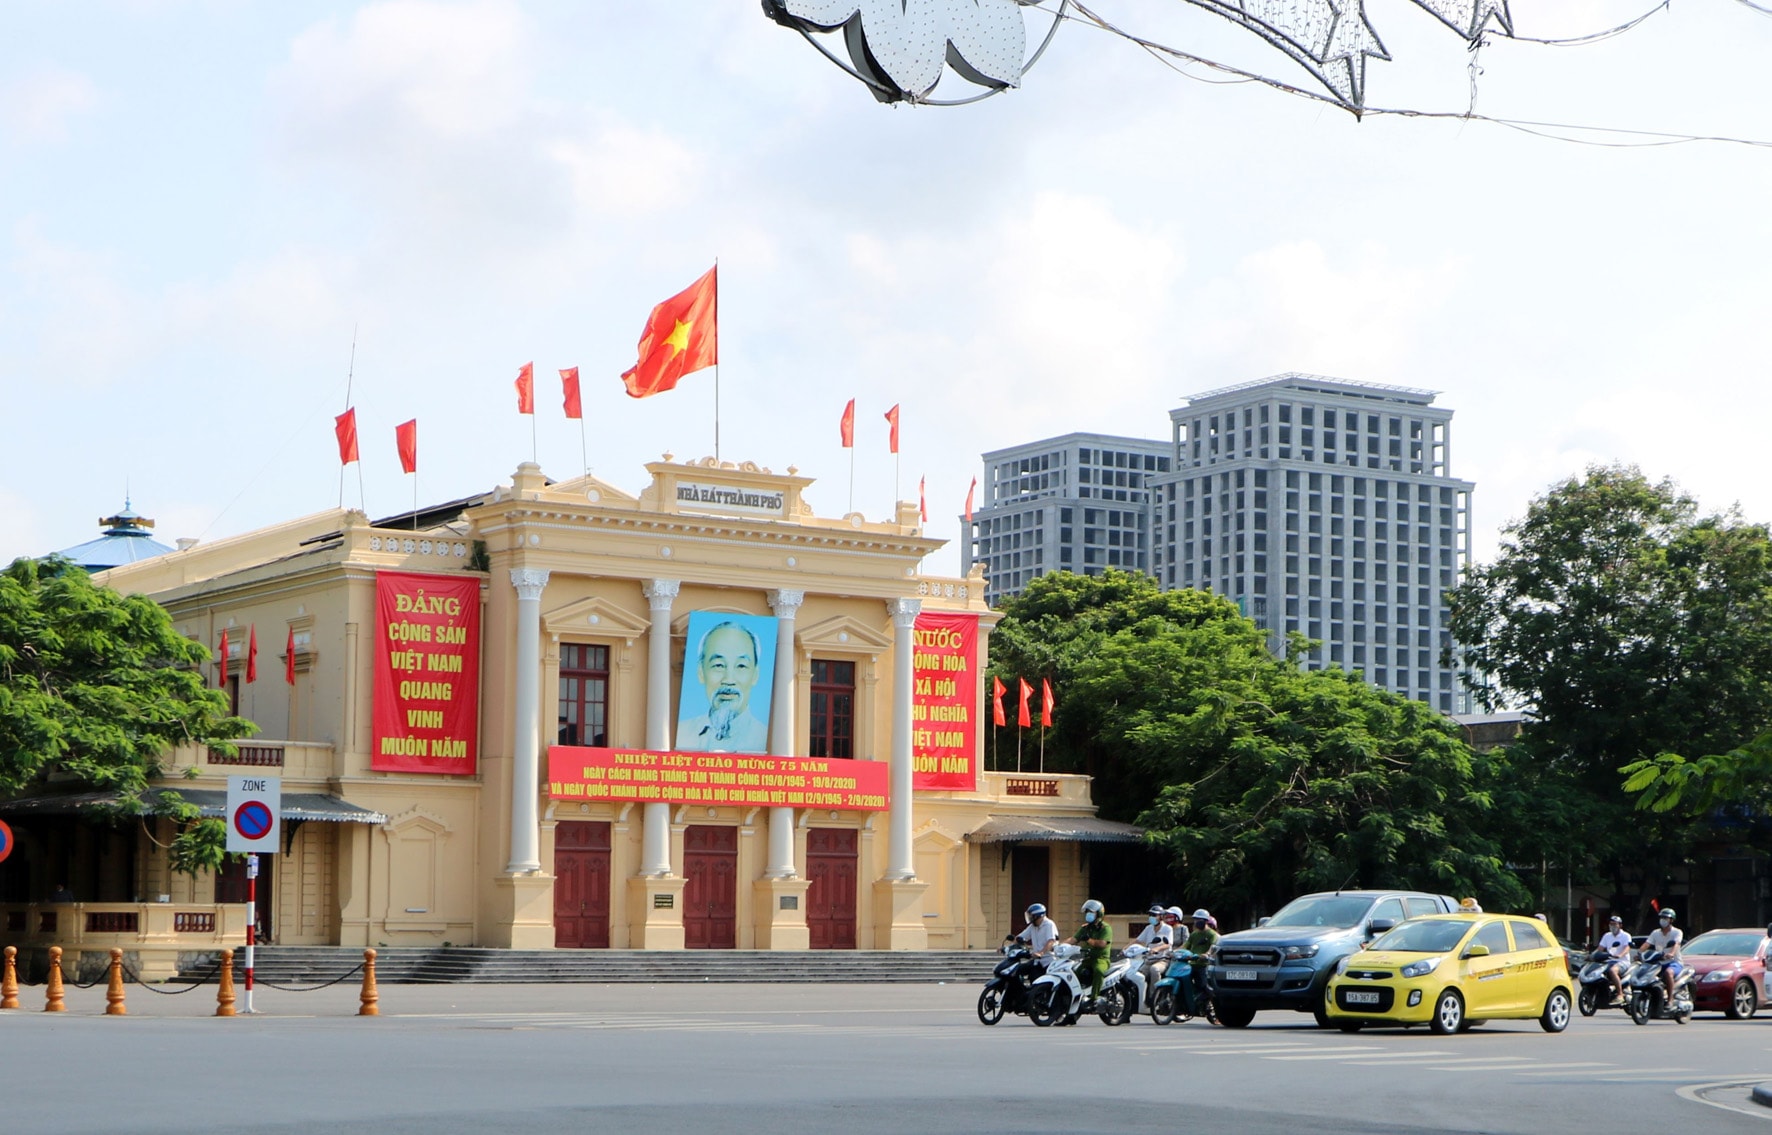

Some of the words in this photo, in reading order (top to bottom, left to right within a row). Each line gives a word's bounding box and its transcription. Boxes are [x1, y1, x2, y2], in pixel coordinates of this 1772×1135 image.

[677, 485, 699, 501] NHÀ
[701, 487, 722, 503] HÁT
[723, 489, 760, 507] THÀNH
[760, 493, 784, 509] PHỐ
[396, 588, 461, 616] ĐẢNG
[389, 619, 431, 645] CỘNG
[436, 619, 466, 644] SẢN
[913, 627, 963, 649] NƯỚC
[391, 649, 424, 674] VIỆT
[428, 653, 462, 673] NAM
[913, 653, 939, 674] ỘNG
[943, 654, 967, 672] HÒA
[400, 680, 452, 700] QUANG
[916, 677, 932, 696] XÃ
[935, 680, 956, 699] HỘI
[407, 709, 443, 728] VINH
[912, 698, 926, 721] HỦ
[930, 704, 968, 722] NGHĨA
[381, 735, 427, 757] MUÔN
[431, 736, 467, 758] NĂM
[912, 728, 932, 750] IỆT
[935, 731, 964, 748] NAM
[615, 753, 658, 766] NHIỆT
[662, 755, 693, 767] LIỆT
[697, 757, 733, 768] CHÀO
[737, 758, 775, 770] MỪNG
[780, 761, 797, 771] 75
[801, 761, 829, 773] NĂM
[912, 753, 937, 773] UÔN
[941, 755, 968, 774] NĂM
[242, 780, 266, 791] ZONE
[584, 766, 606, 779] NGÀY
[608, 766, 631, 781] CÁCH
[634, 769, 658, 783] MẠNG
[660, 769, 687, 783] THÁNG
[690, 769, 707, 783] TÁM
[709, 771, 736, 784] THÀNH
[738, 772, 760, 785] CÔNG
